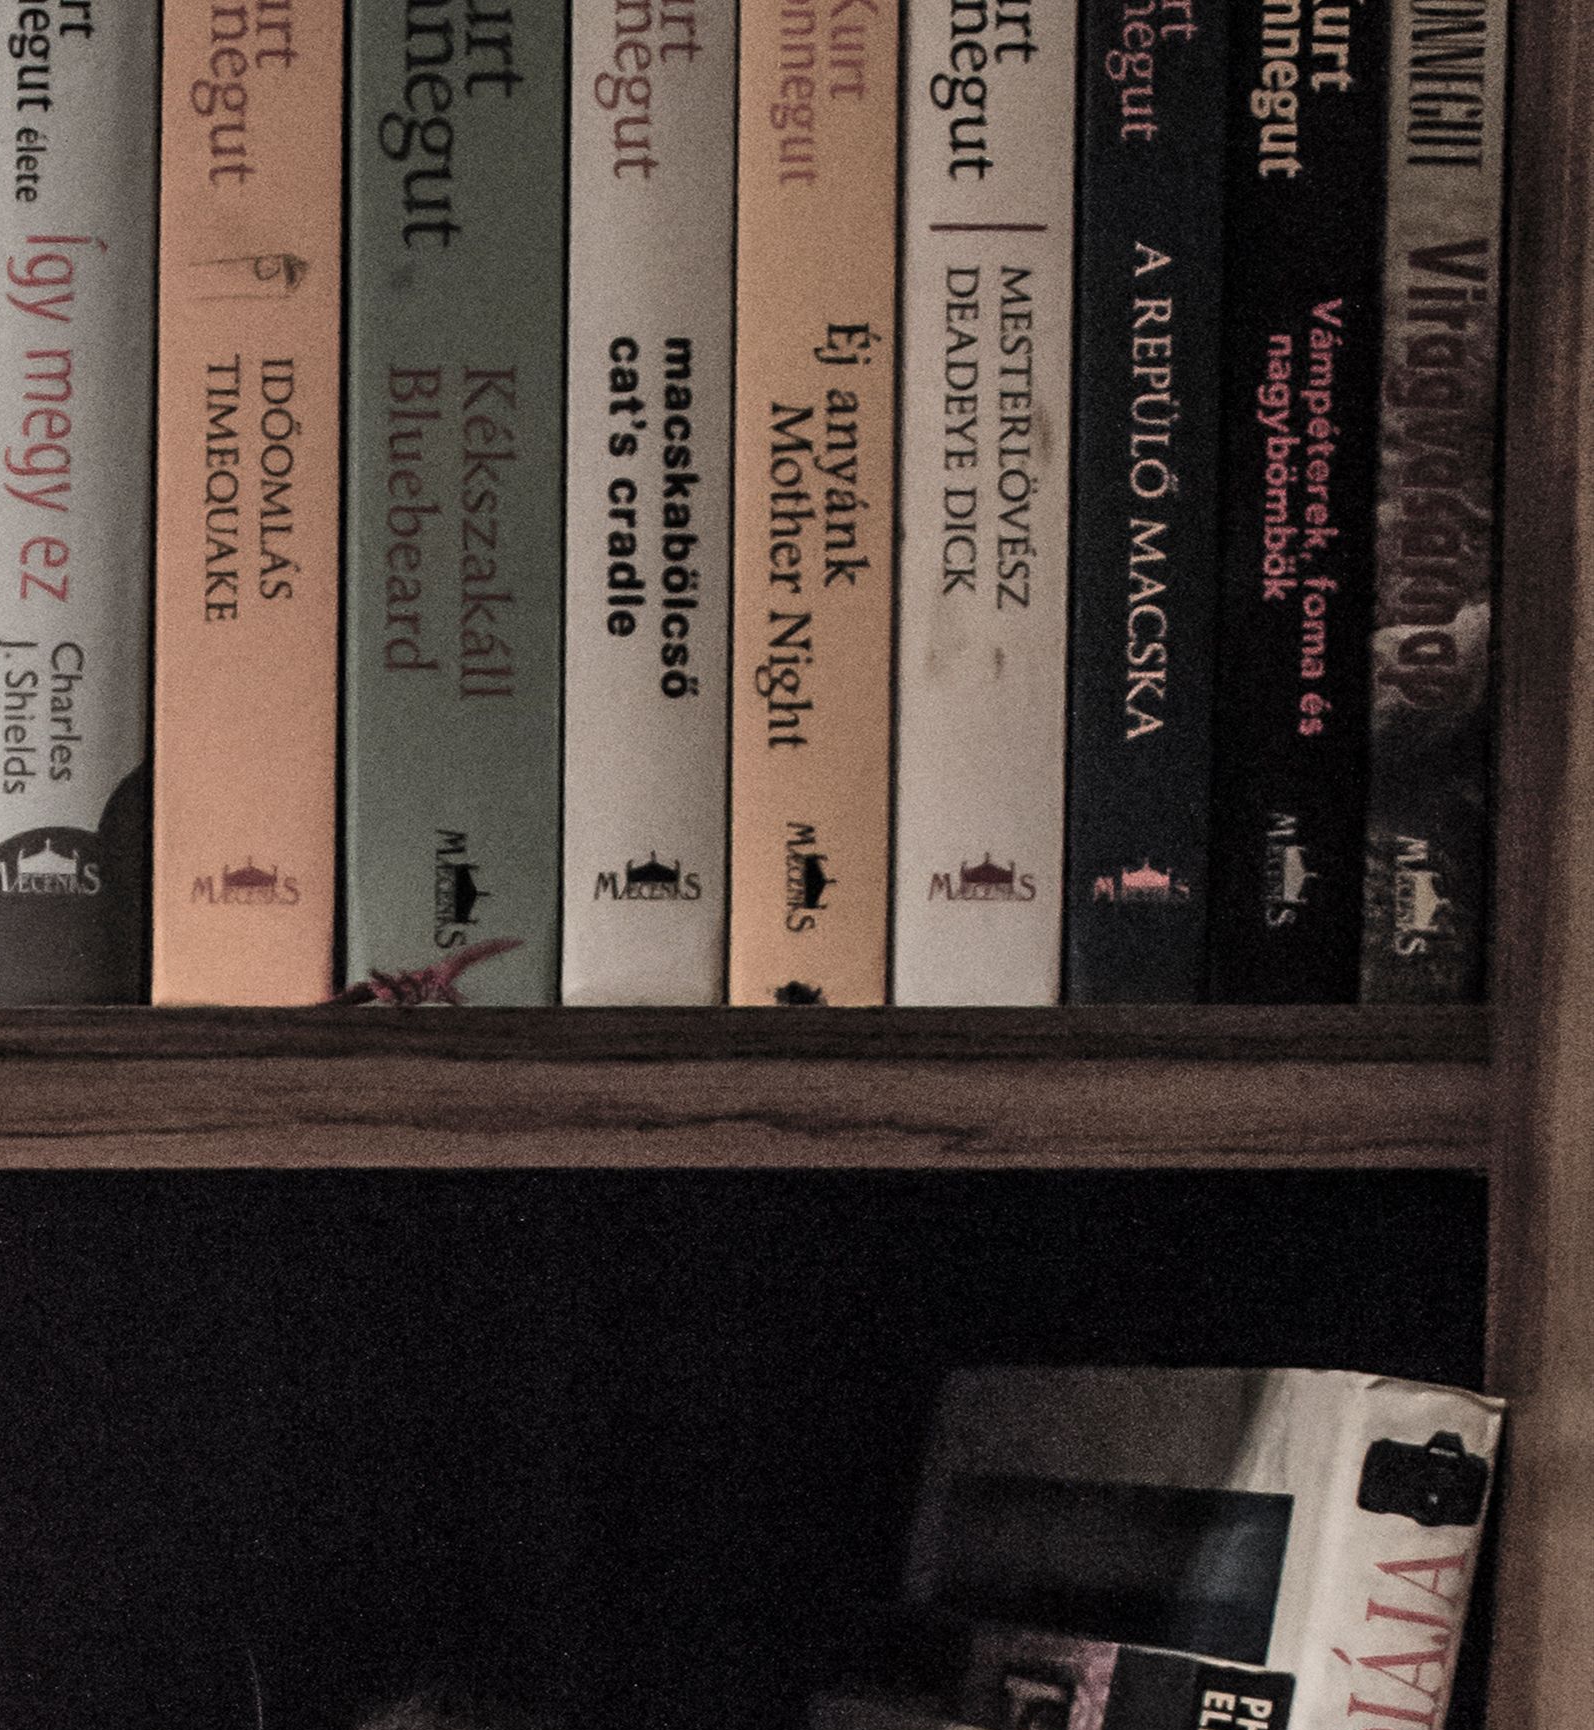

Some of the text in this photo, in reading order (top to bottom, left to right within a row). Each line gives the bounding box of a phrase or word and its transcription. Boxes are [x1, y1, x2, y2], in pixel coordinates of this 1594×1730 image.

[15, 124, 51, 204] élete
[4, 228, 108, 601] Így megy ez
[199, 354, 304, 624] IDŐOMLÁS TIMEQUAKE
[382, 363, 519, 702] Kékszakáll Bluebeard
[606, 336, 700, 702] macskabölcső cat's cradle
[754, 387, 870, 750] anyánk Mother Night
[939, 266, 1035, 612] MESTERLÖVÉSZ DEADEYE DICK
[1124, 242, 1184, 743] A REPÜLŐ MACSKA
[1256, 298, 1344, 601] Vámpéterek, nagybömbök
[1, 640, 86, 797] Charles Shields
